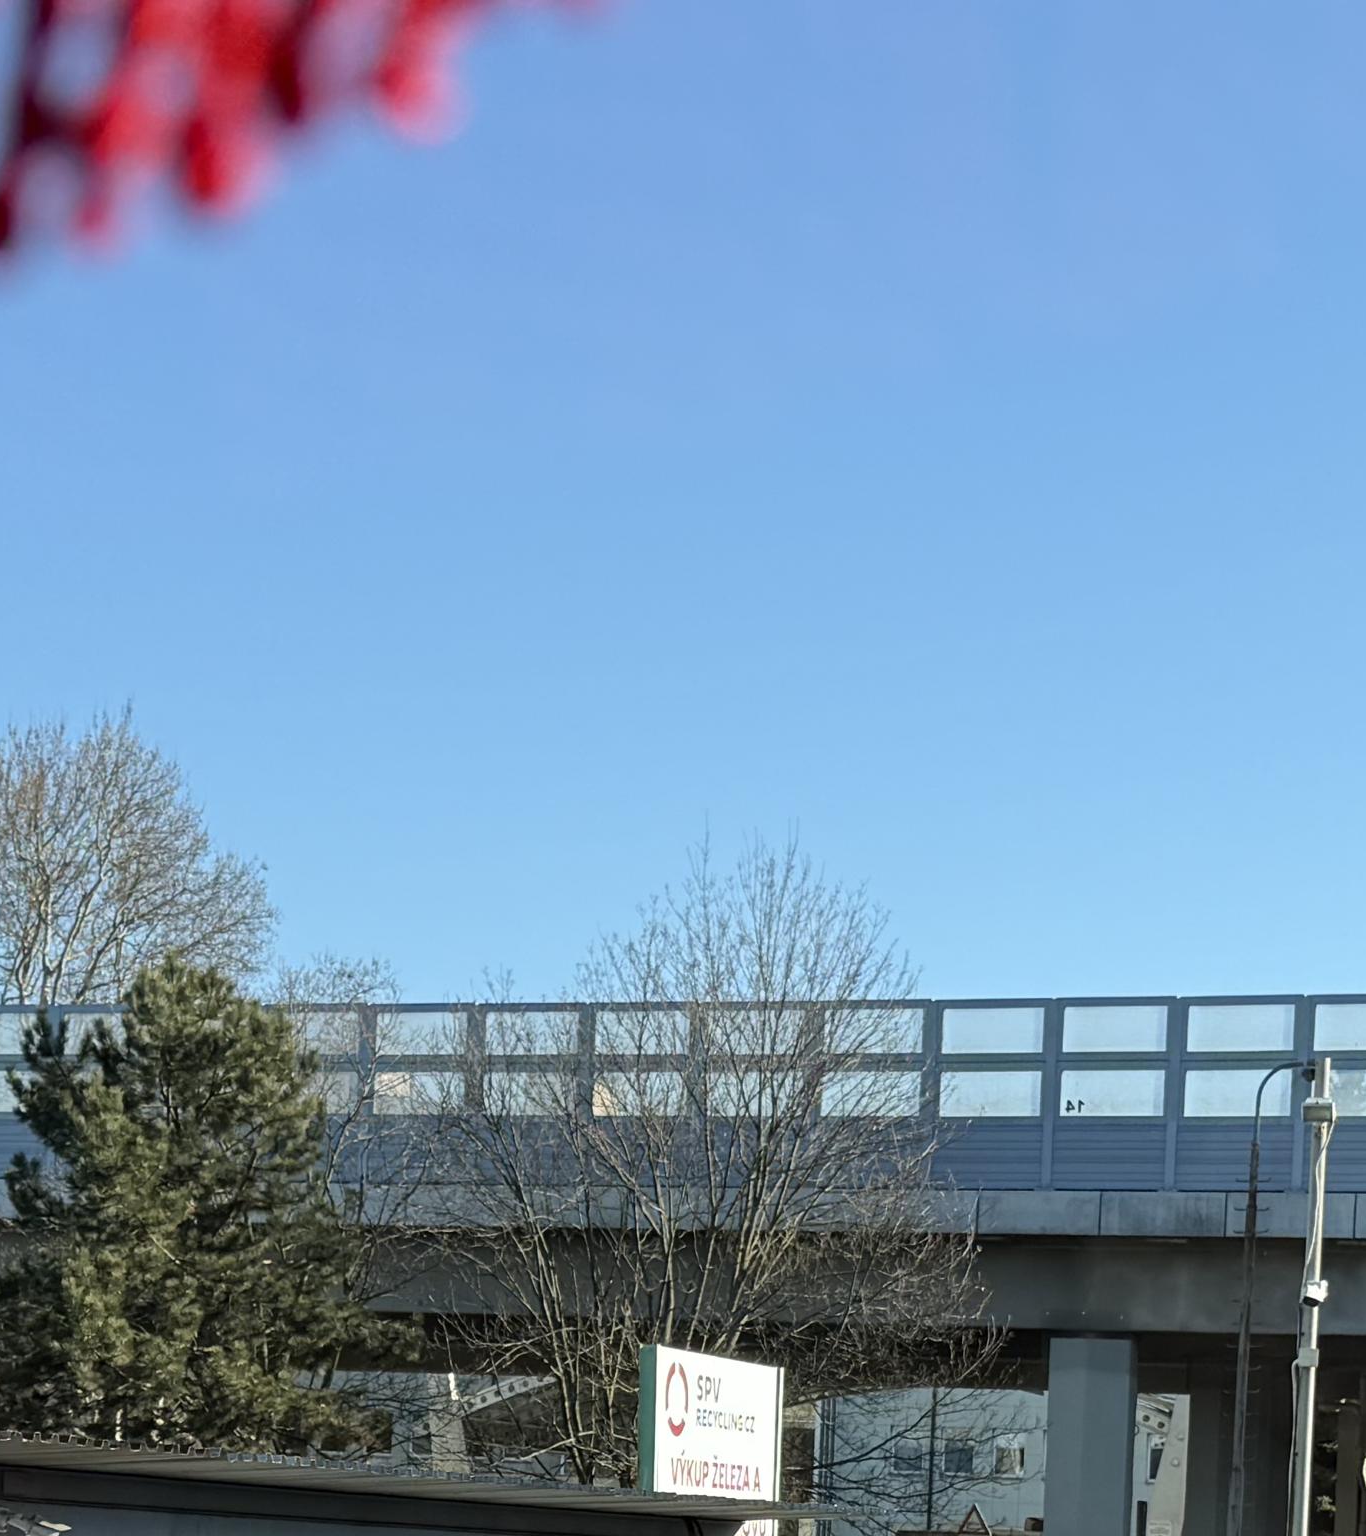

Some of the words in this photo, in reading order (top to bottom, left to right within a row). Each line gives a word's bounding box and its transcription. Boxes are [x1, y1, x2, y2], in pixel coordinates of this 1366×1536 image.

[697, 1374, 721, 1403] SPV
[671, 1449, 709, 1488] VÝKUP
[712, 1454, 750, 1491] ŽELEZA
[752, 1466, 761, 1492] A
